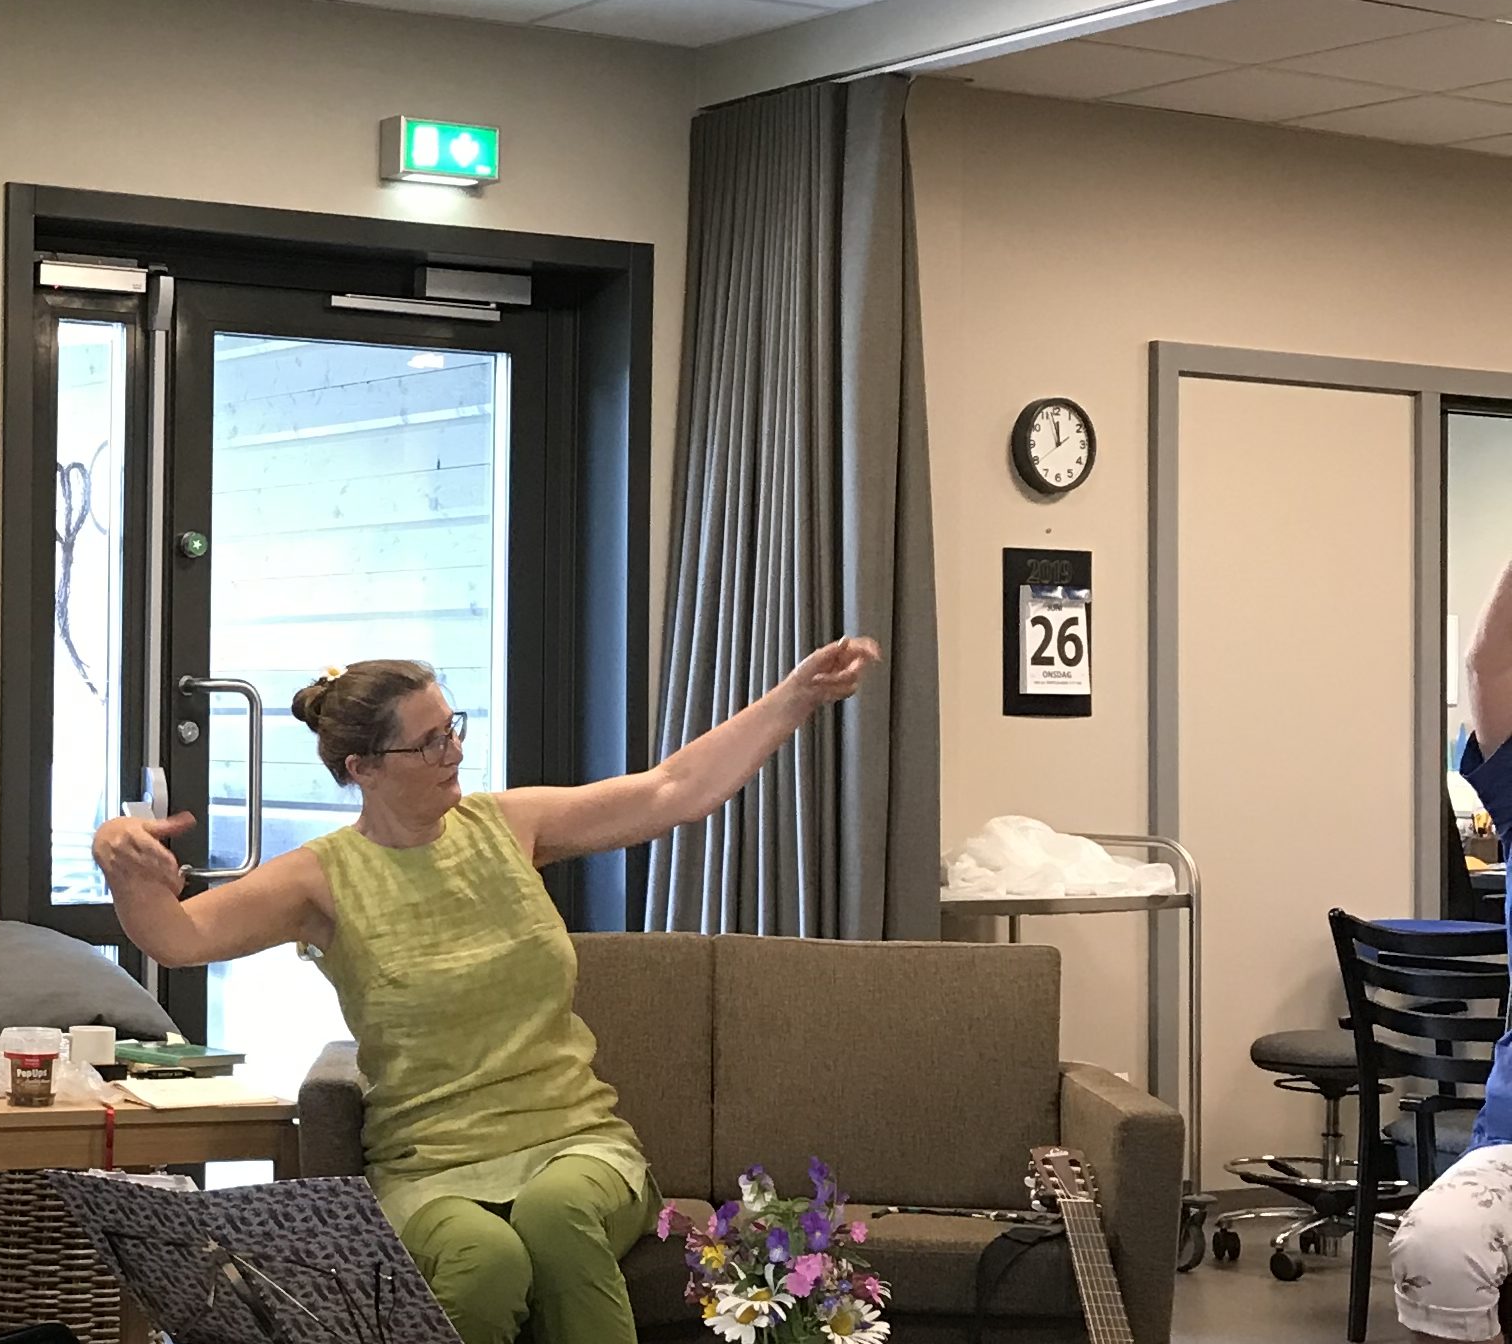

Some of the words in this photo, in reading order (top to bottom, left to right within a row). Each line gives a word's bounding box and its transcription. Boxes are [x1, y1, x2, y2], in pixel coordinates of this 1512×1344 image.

[1075, 424, 1082, 433] 2
[1076, 456, 1083, 465] 4
[1043, 468, 1049, 477] 7
[1067, 469, 1074, 478] 5
[1055, 473, 1062, 482] 6
[1026, 558, 1073, 584] 2019
[1030, 615, 1084, 667] 26
[1042, 670, 1073, 679] ONSDAG
